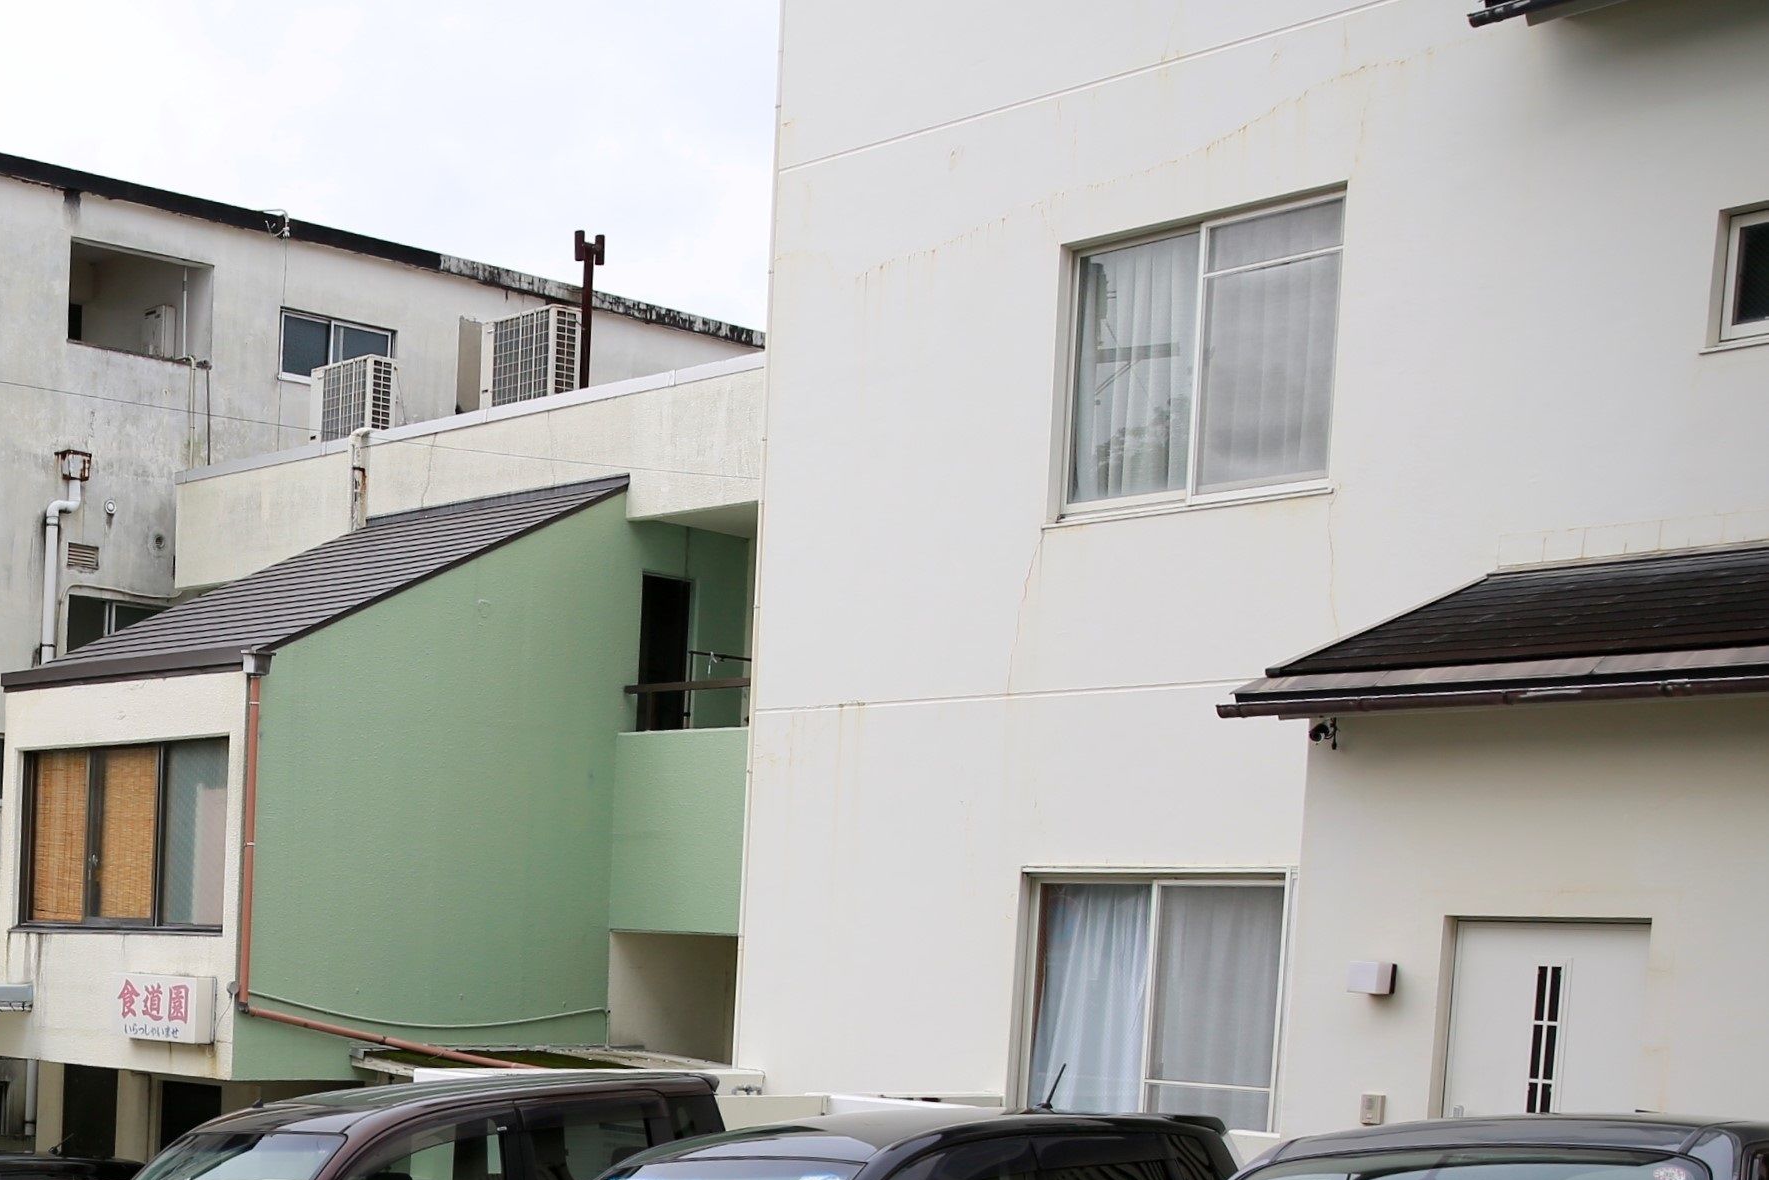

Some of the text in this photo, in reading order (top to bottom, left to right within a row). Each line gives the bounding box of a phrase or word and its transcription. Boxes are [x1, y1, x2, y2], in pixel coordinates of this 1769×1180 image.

[117, 978, 190, 1024] 食道園
[124, 1023, 180, 1039] いらっしゃいませ
